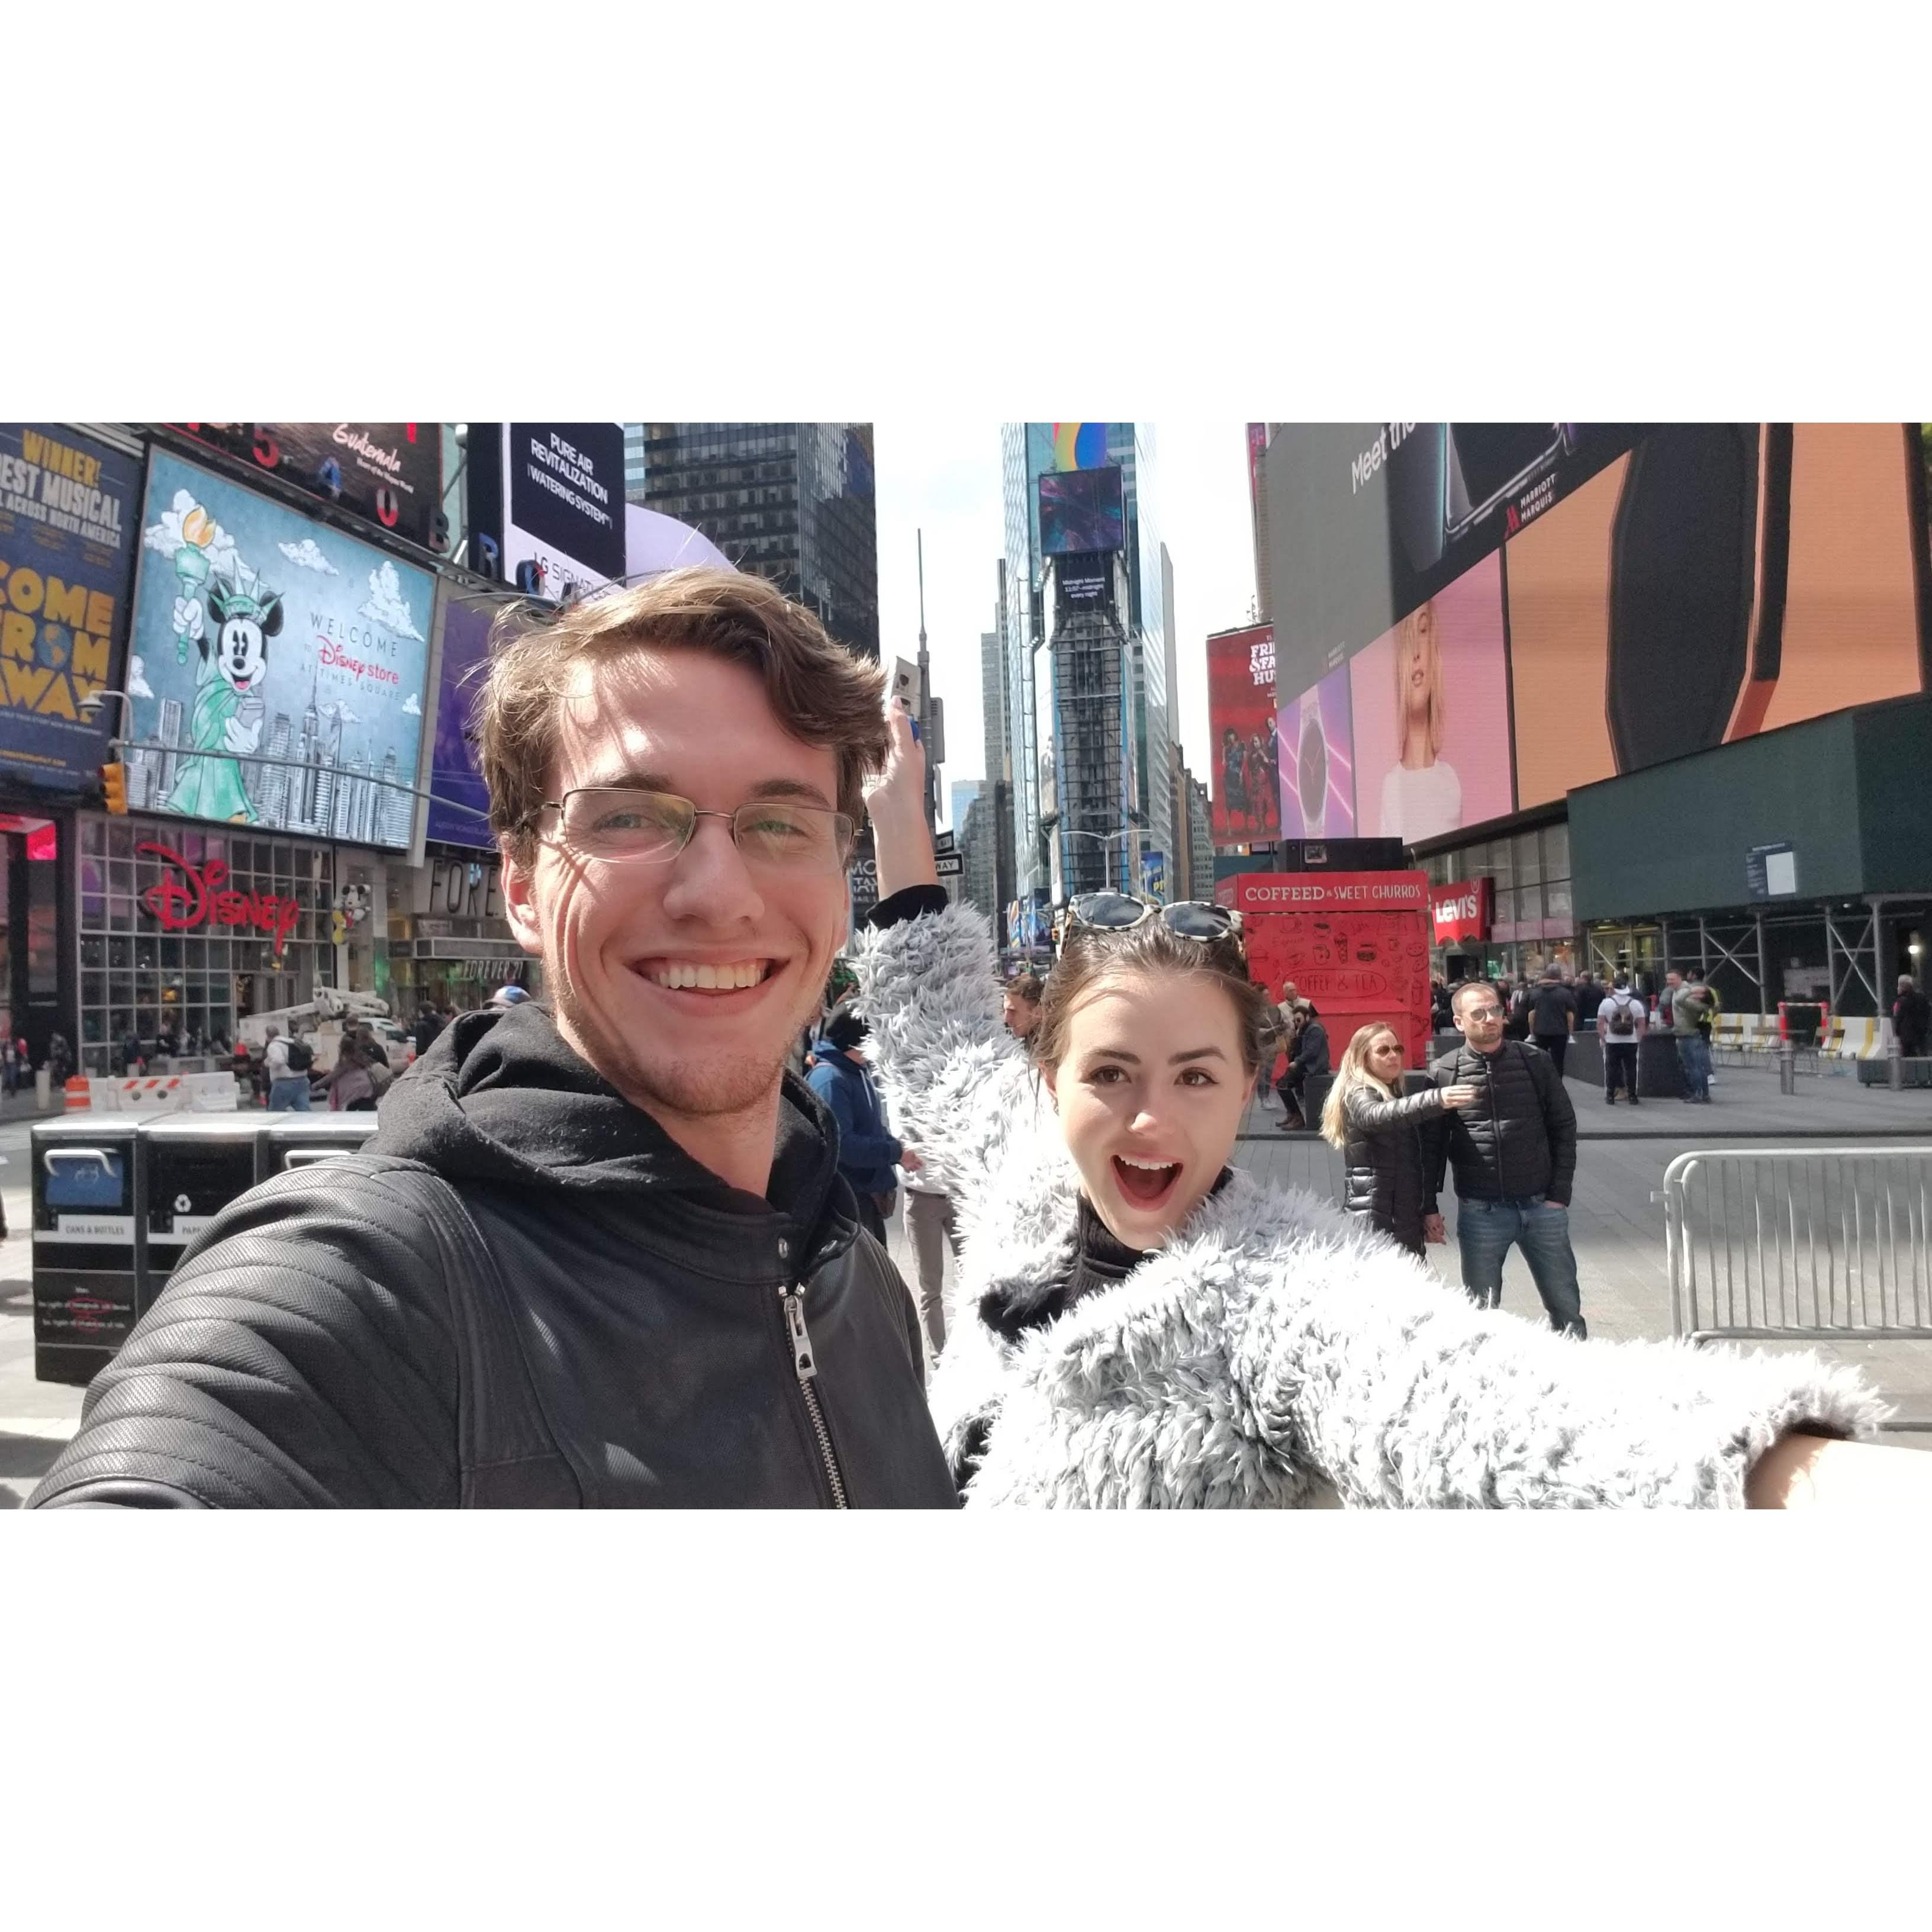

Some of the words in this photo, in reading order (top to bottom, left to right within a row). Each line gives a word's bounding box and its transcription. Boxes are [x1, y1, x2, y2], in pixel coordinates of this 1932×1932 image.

[22, 429, 101, 489] WINNER!
[333, 423, 401, 472] Guatemala
[550, 432, 577, 464] PURE
[577, 453, 594, 476] AIR
[1351, 426, 1387, 495] Meet
[0, 452, 41, 499] EST
[41, 471, 122, 532] MUSICAL
[531, 437, 608, 504] REVITALIZATION
[1520, 473, 1556, 509] MARRIOTT
[1521, 491, 1553, 523] MARQUIS
[311, 612, 398, 656] WELCOME
[317, 635, 365, 681] Disney
[367, 664, 399, 685] store
[320, 668, 352, 687] TIMES
[1253, 669, 1276, 685] HU
[136, 842, 300, 957] Disney
[1245, 886, 1325, 901] COFFEED
[1334, 886, 1368, 900] SWEET
[1371, 884, 1421, 899] CHURROS
[463, 959, 510, 980] FOREVER
[1354, 974, 1377, 991] TEA
[66, 1225, 85, 1235] CANS
[94, 1225, 124, 1235] BOTTLES
